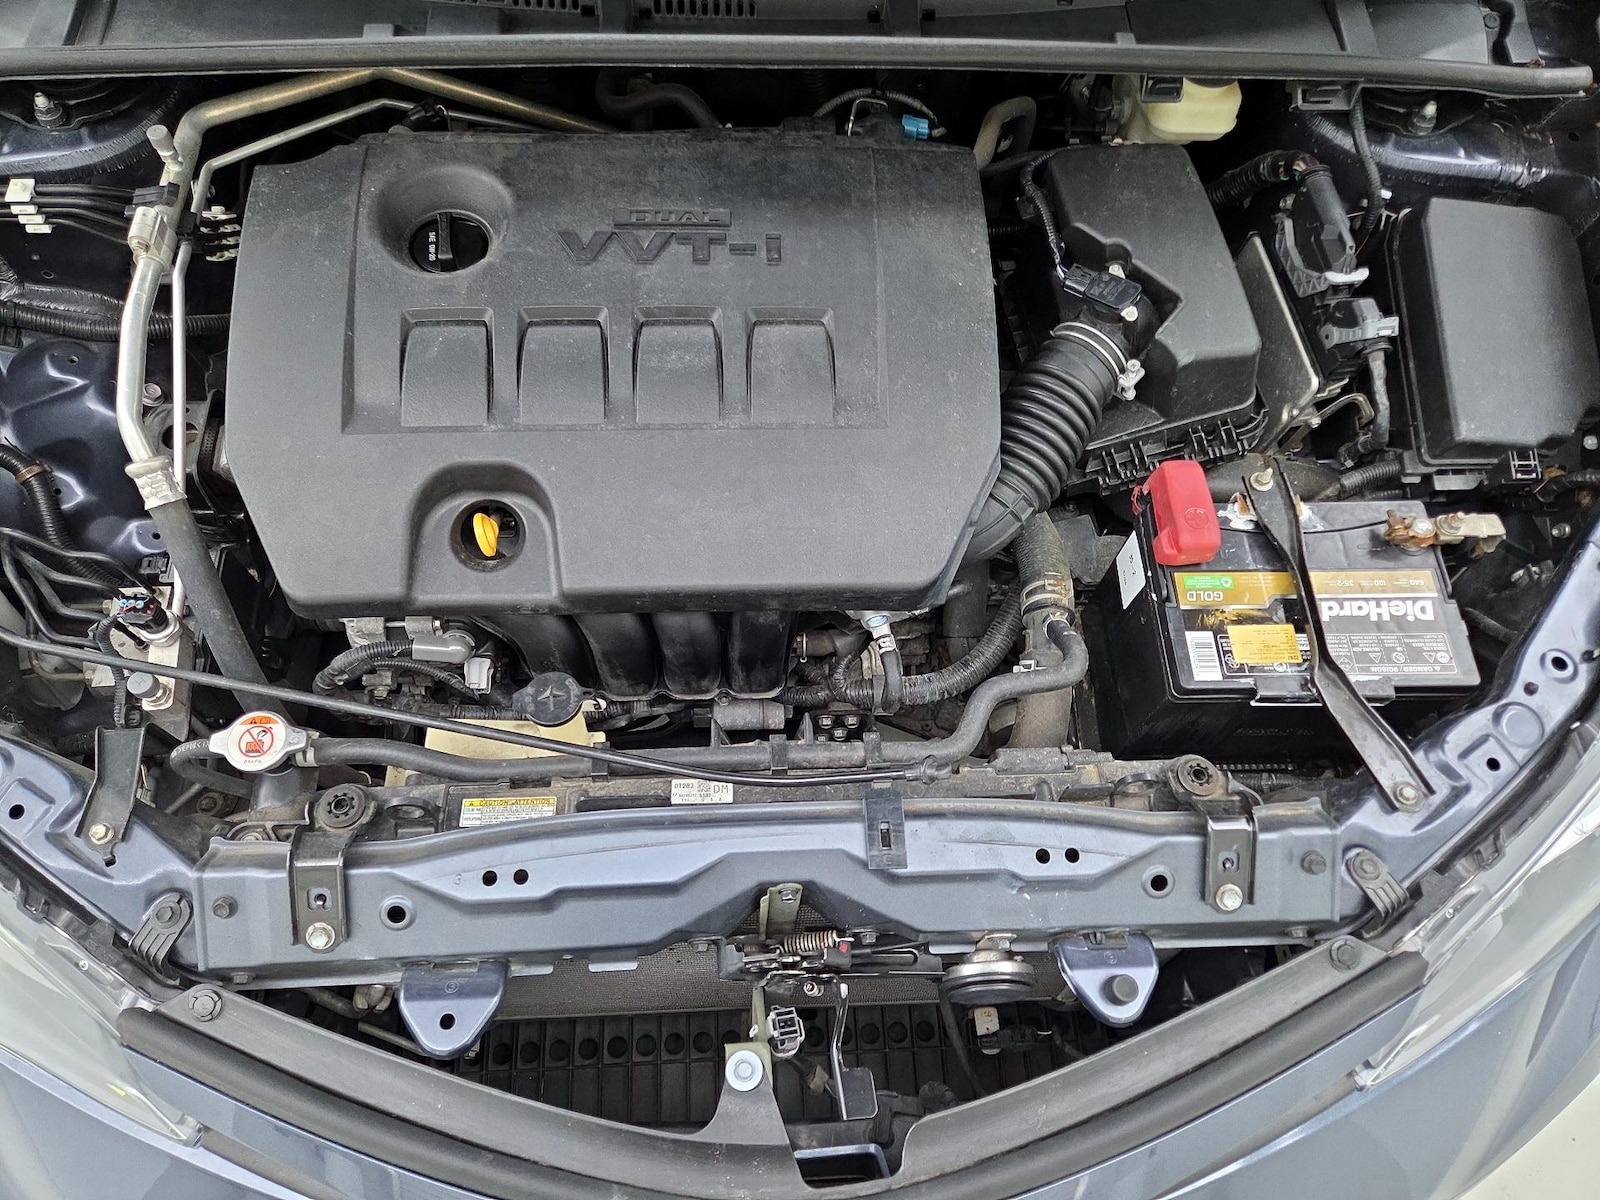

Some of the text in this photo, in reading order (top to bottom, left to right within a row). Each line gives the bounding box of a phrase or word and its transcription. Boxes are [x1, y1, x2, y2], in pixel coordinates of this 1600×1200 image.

[629, 210, 721, 223] DUAL
[428, 231, 436, 242] SAE
[1186, 590, 1224, 602] GOLD
[1321, 600, 1435, 622] DieHard
[713, 784, 729, 794] DM
[480, 799, 508, 807] CAUTION
